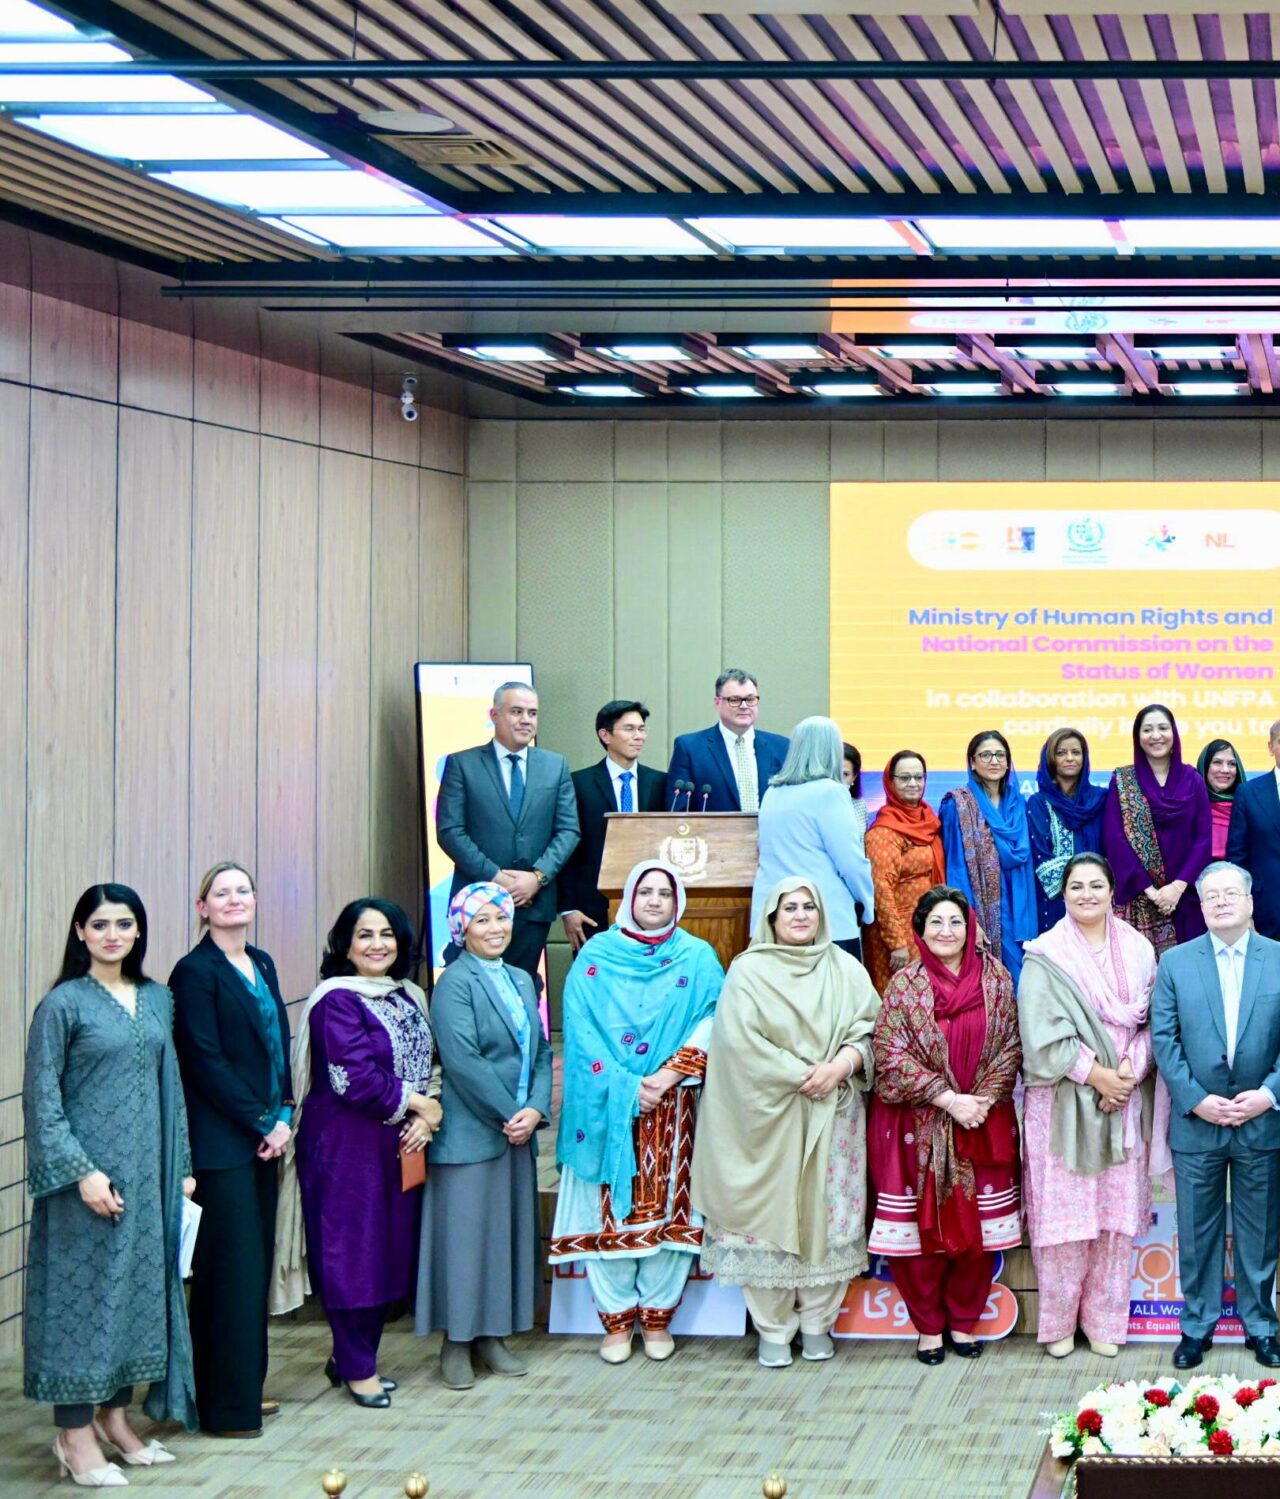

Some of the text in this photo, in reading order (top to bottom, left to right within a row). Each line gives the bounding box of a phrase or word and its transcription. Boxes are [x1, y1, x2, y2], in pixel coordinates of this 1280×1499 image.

[1204, 532, 1236, 549] NL
[908, 607, 1273, 630] Ministry of Human Rights and
[922, 634, 1274, 653] National Commission on the
[1061, 662, 1274, 680] Status of Women
[956, 689, 1128, 708] collaboration
[1132, 689, 1187, 708] with
[1193, 690, 1275, 708] UNFPA
[1003, 715, 1113, 740] cordially
[1195, 720, 1243, 741] you
[1249, 718, 1270, 735] to
[1133, 1304, 1158, 1316] ALL
